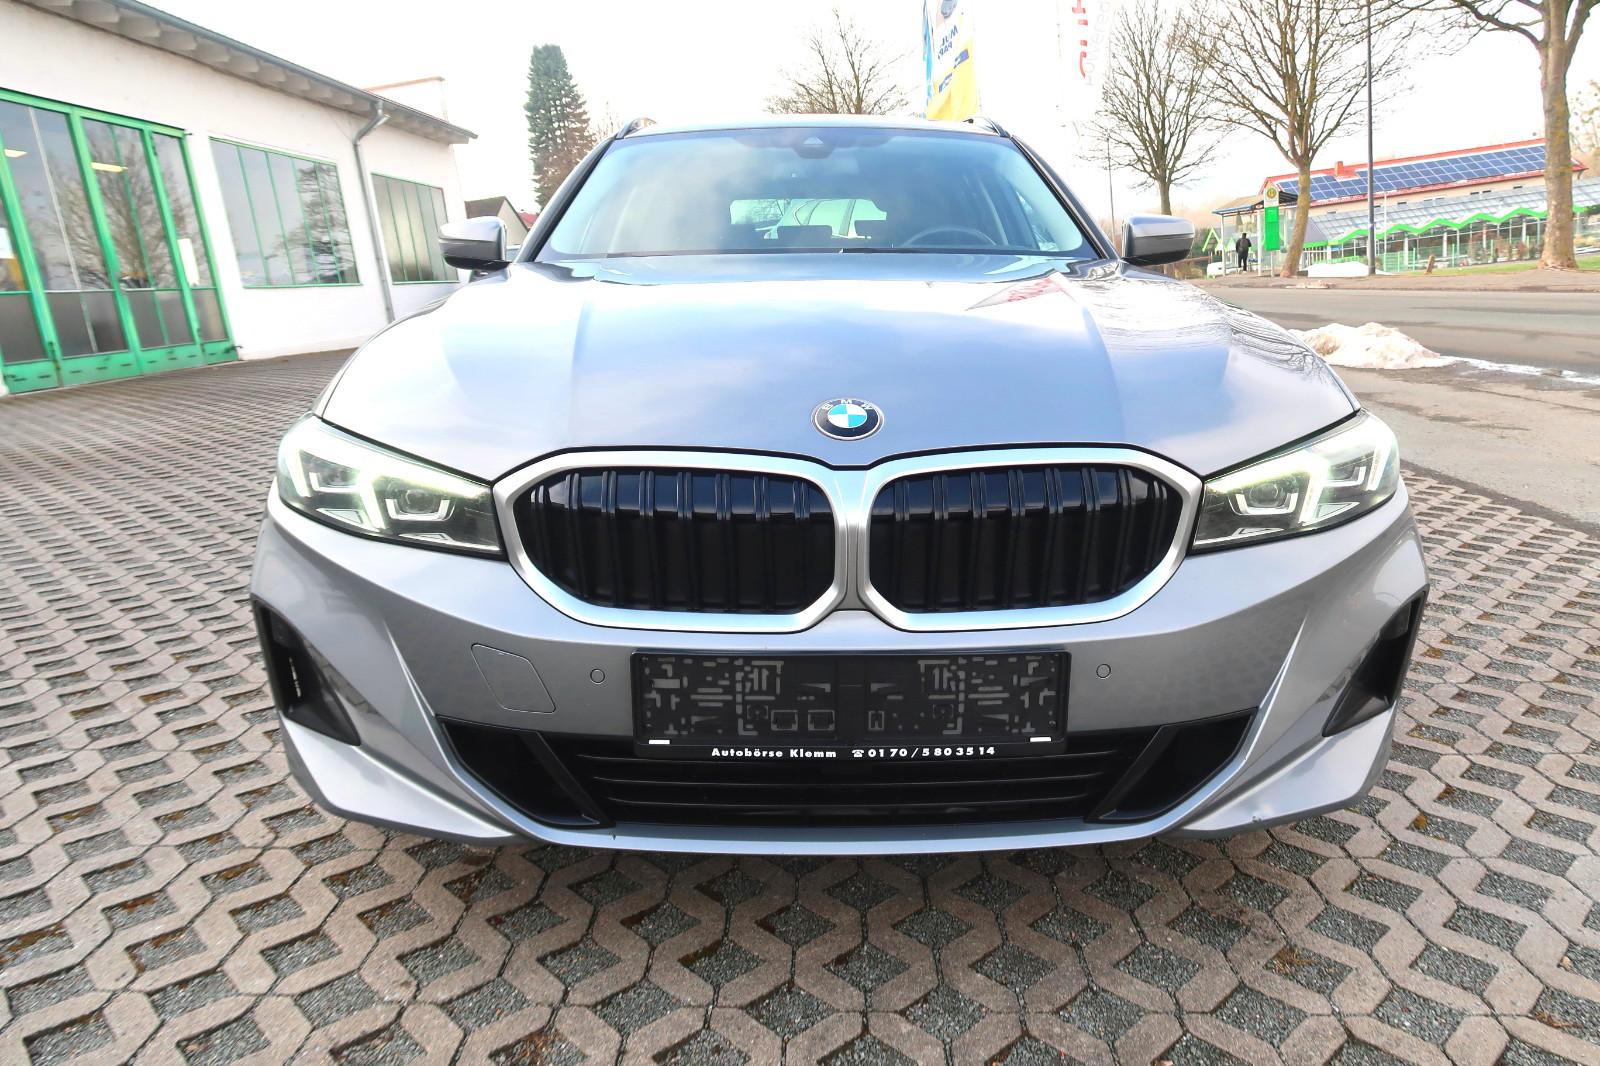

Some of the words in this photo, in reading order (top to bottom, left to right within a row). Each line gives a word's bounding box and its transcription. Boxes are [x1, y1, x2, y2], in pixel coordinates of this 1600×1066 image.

[821, 399, 873, 410] BMW
[711, 747, 784, 758] Autobörse
[789, 748, 837, 758] Klemm
